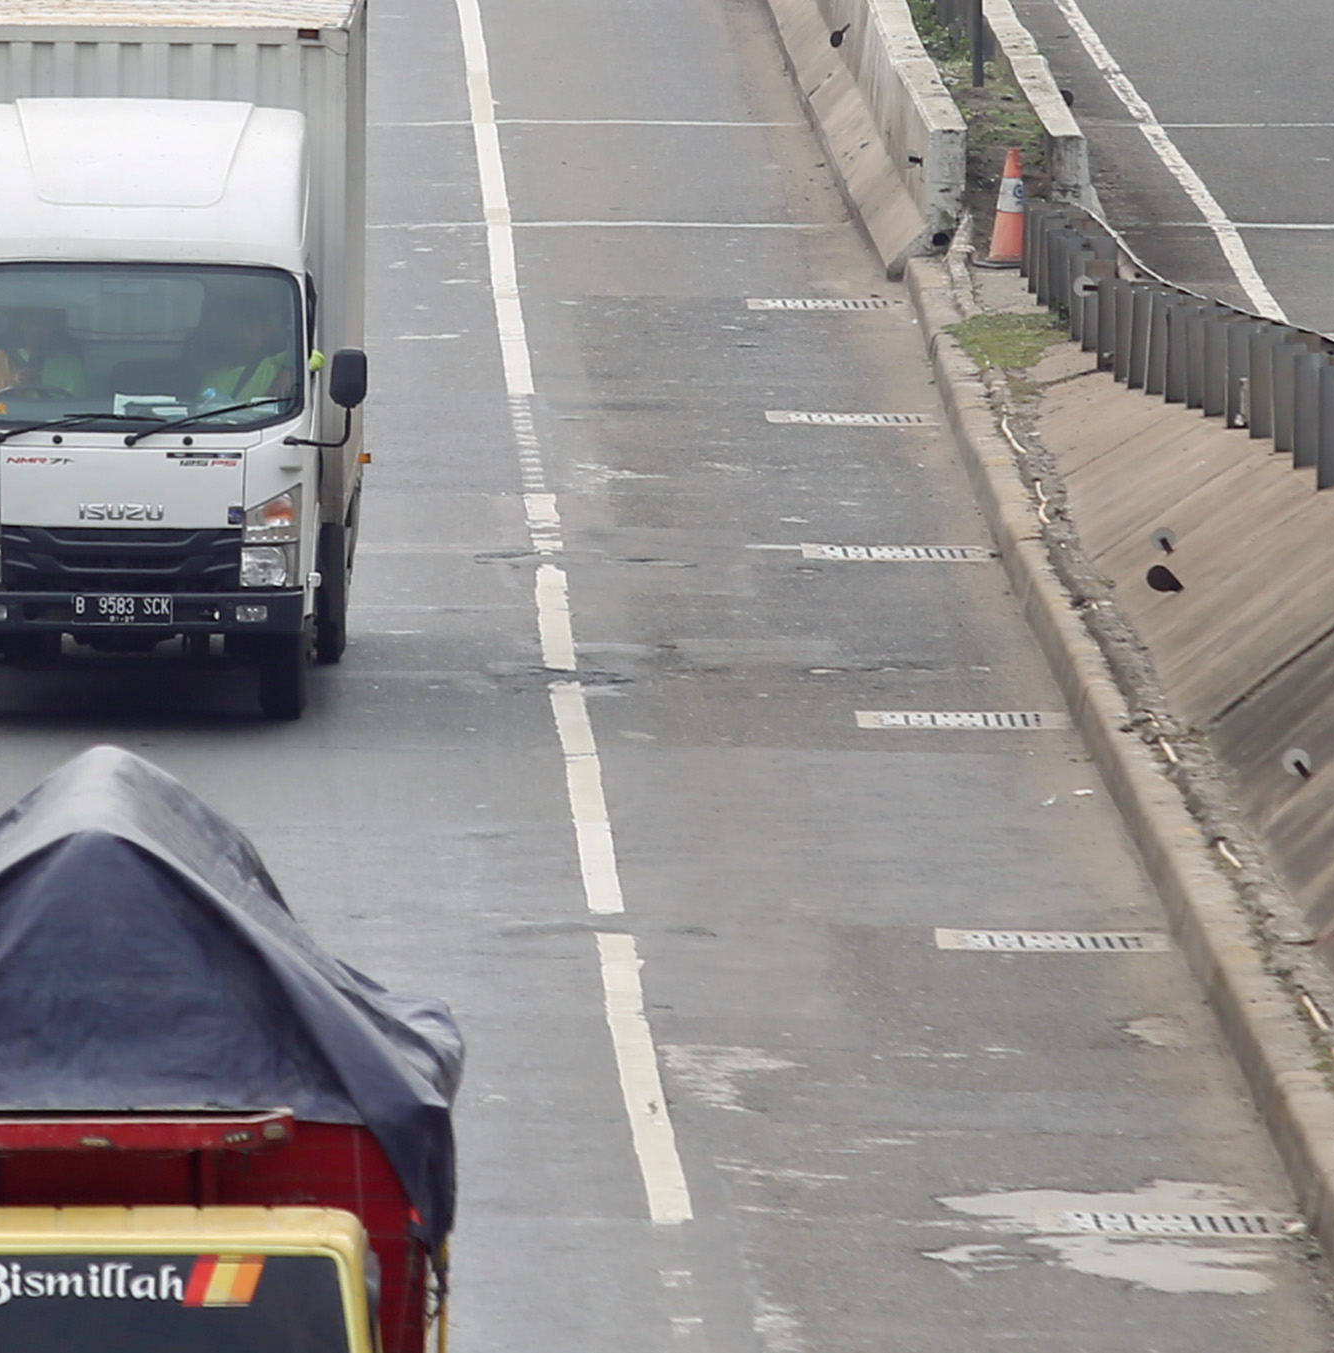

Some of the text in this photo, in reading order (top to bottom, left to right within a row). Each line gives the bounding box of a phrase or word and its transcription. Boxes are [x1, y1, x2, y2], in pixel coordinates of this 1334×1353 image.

[211, 459, 238, 468] PS
[78, 503, 164, 521] ISUZU
[75, 596, 170, 616] B 9583 SCK
